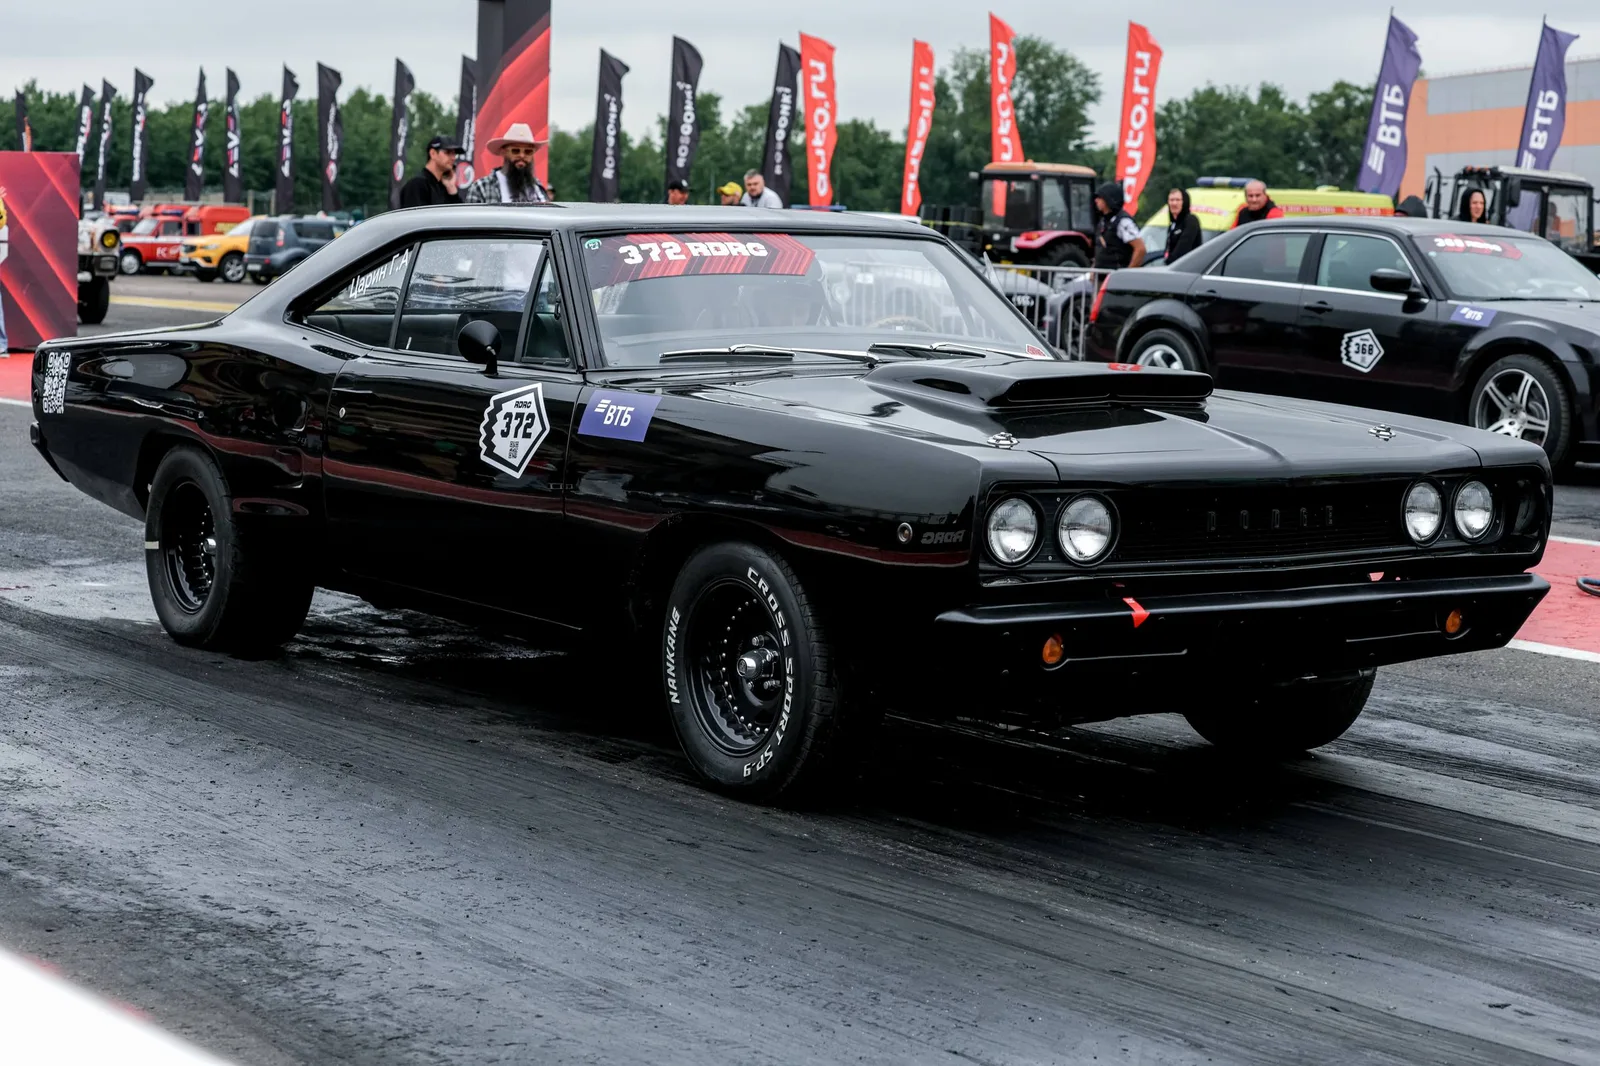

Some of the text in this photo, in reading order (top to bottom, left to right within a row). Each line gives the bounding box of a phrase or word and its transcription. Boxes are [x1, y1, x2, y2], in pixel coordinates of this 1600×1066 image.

[809, 59, 831, 197] auto.ru
[996, 42, 1013, 162] uto.ru
[1119, 51, 1151, 203] auto.ru
[1376, 84, 1404, 147] ВТБ
[1529, 90, 1559, 150] ВТБ
[349, 264, 388, 299] Царин
[619, 241, 686, 265] 372
[1354, 342, 1374, 355] 368
[500, 412, 536, 439] 372
[603, 405, 635, 427] ВТБ
[665, 606, 682, 704] NANKANG
[746, 566, 791, 648] CROSS
[775, 656, 796, 746] SPORT
